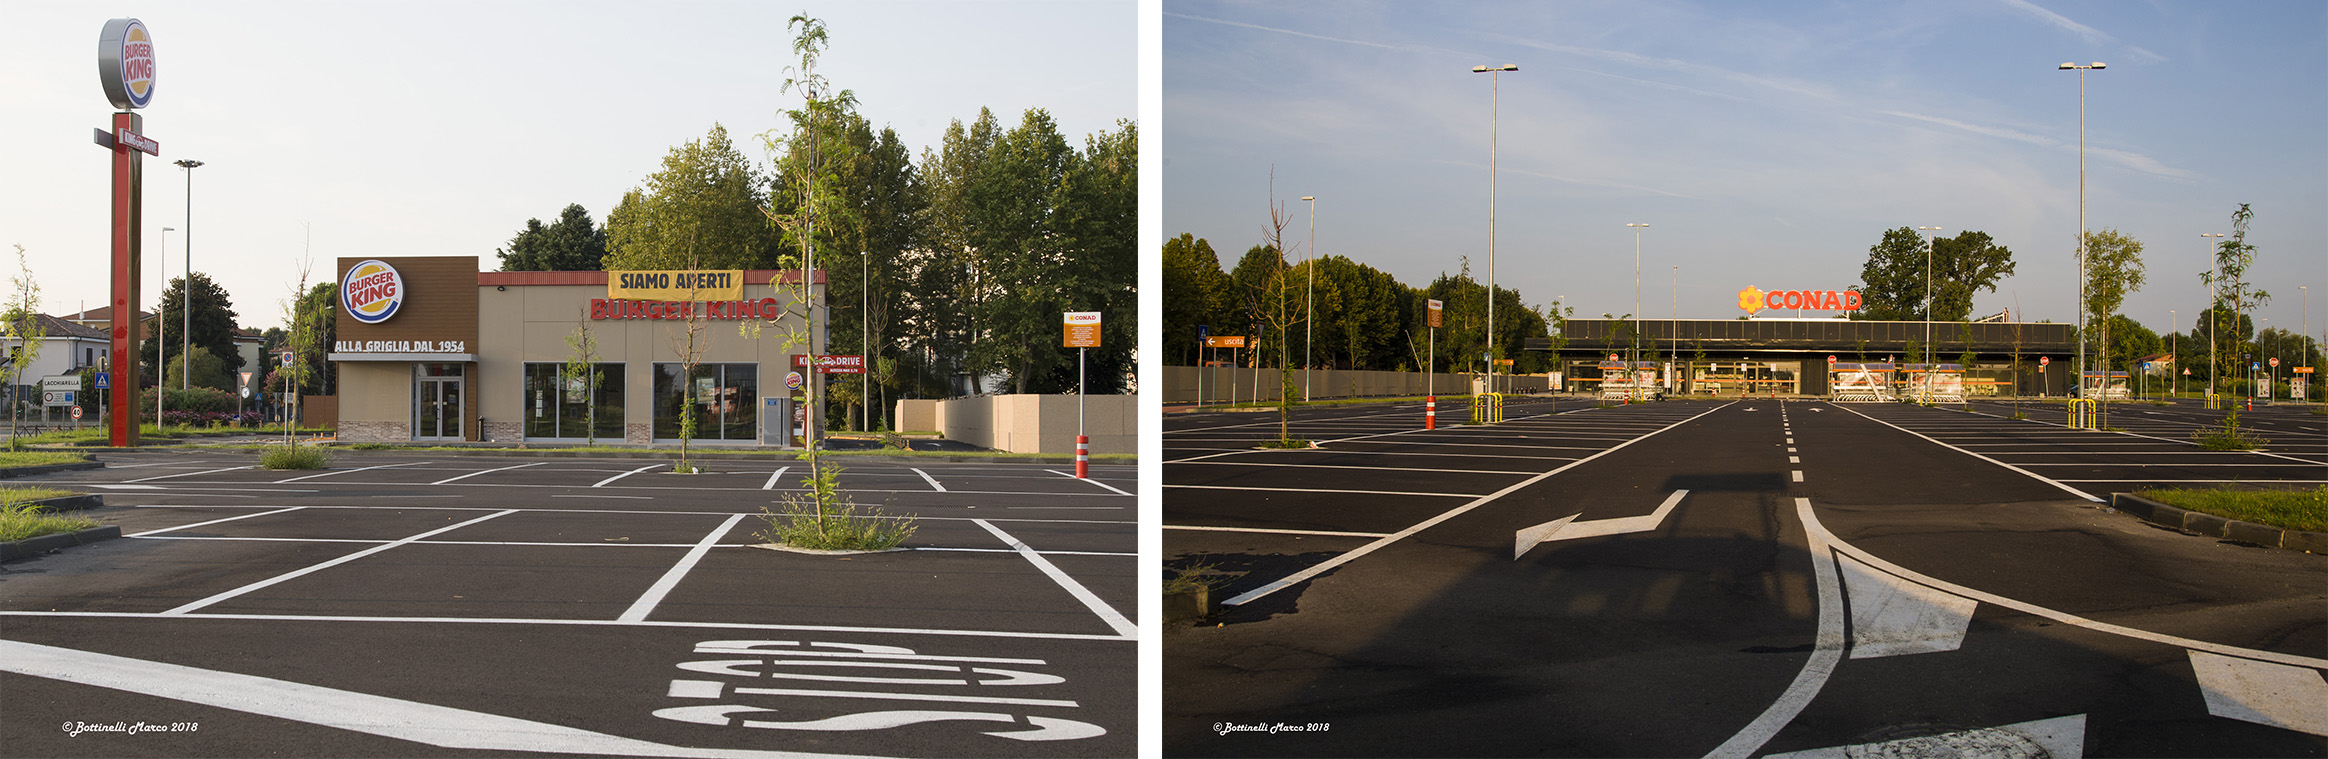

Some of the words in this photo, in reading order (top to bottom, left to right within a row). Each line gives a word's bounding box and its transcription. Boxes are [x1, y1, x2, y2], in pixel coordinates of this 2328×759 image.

[125, 43, 151, 60] BURGER
[125, 58, 152, 82] KING
[349, 271, 394, 295] BURGER
[620, 273, 669, 289] SIAMO
[675, 273, 731, 289] APERTI
[351, 282, 396, 310] KING
[1765, 290, 1863, 311] CONAD
[590, 298, 697, 320] BURGER
[706, 297, 778, 320] KING
[334, 340, 362, 353] ALLA
[365, 340, 410, 353] GRIGLIA
[413, 340, 435, 353] DAL
[438, 340, 465, 353] 1954
[799, 357, 819, 365] KIG
[836, 357, 860, 365] DRIVE
[651, 640, 1107, 741] STOP
